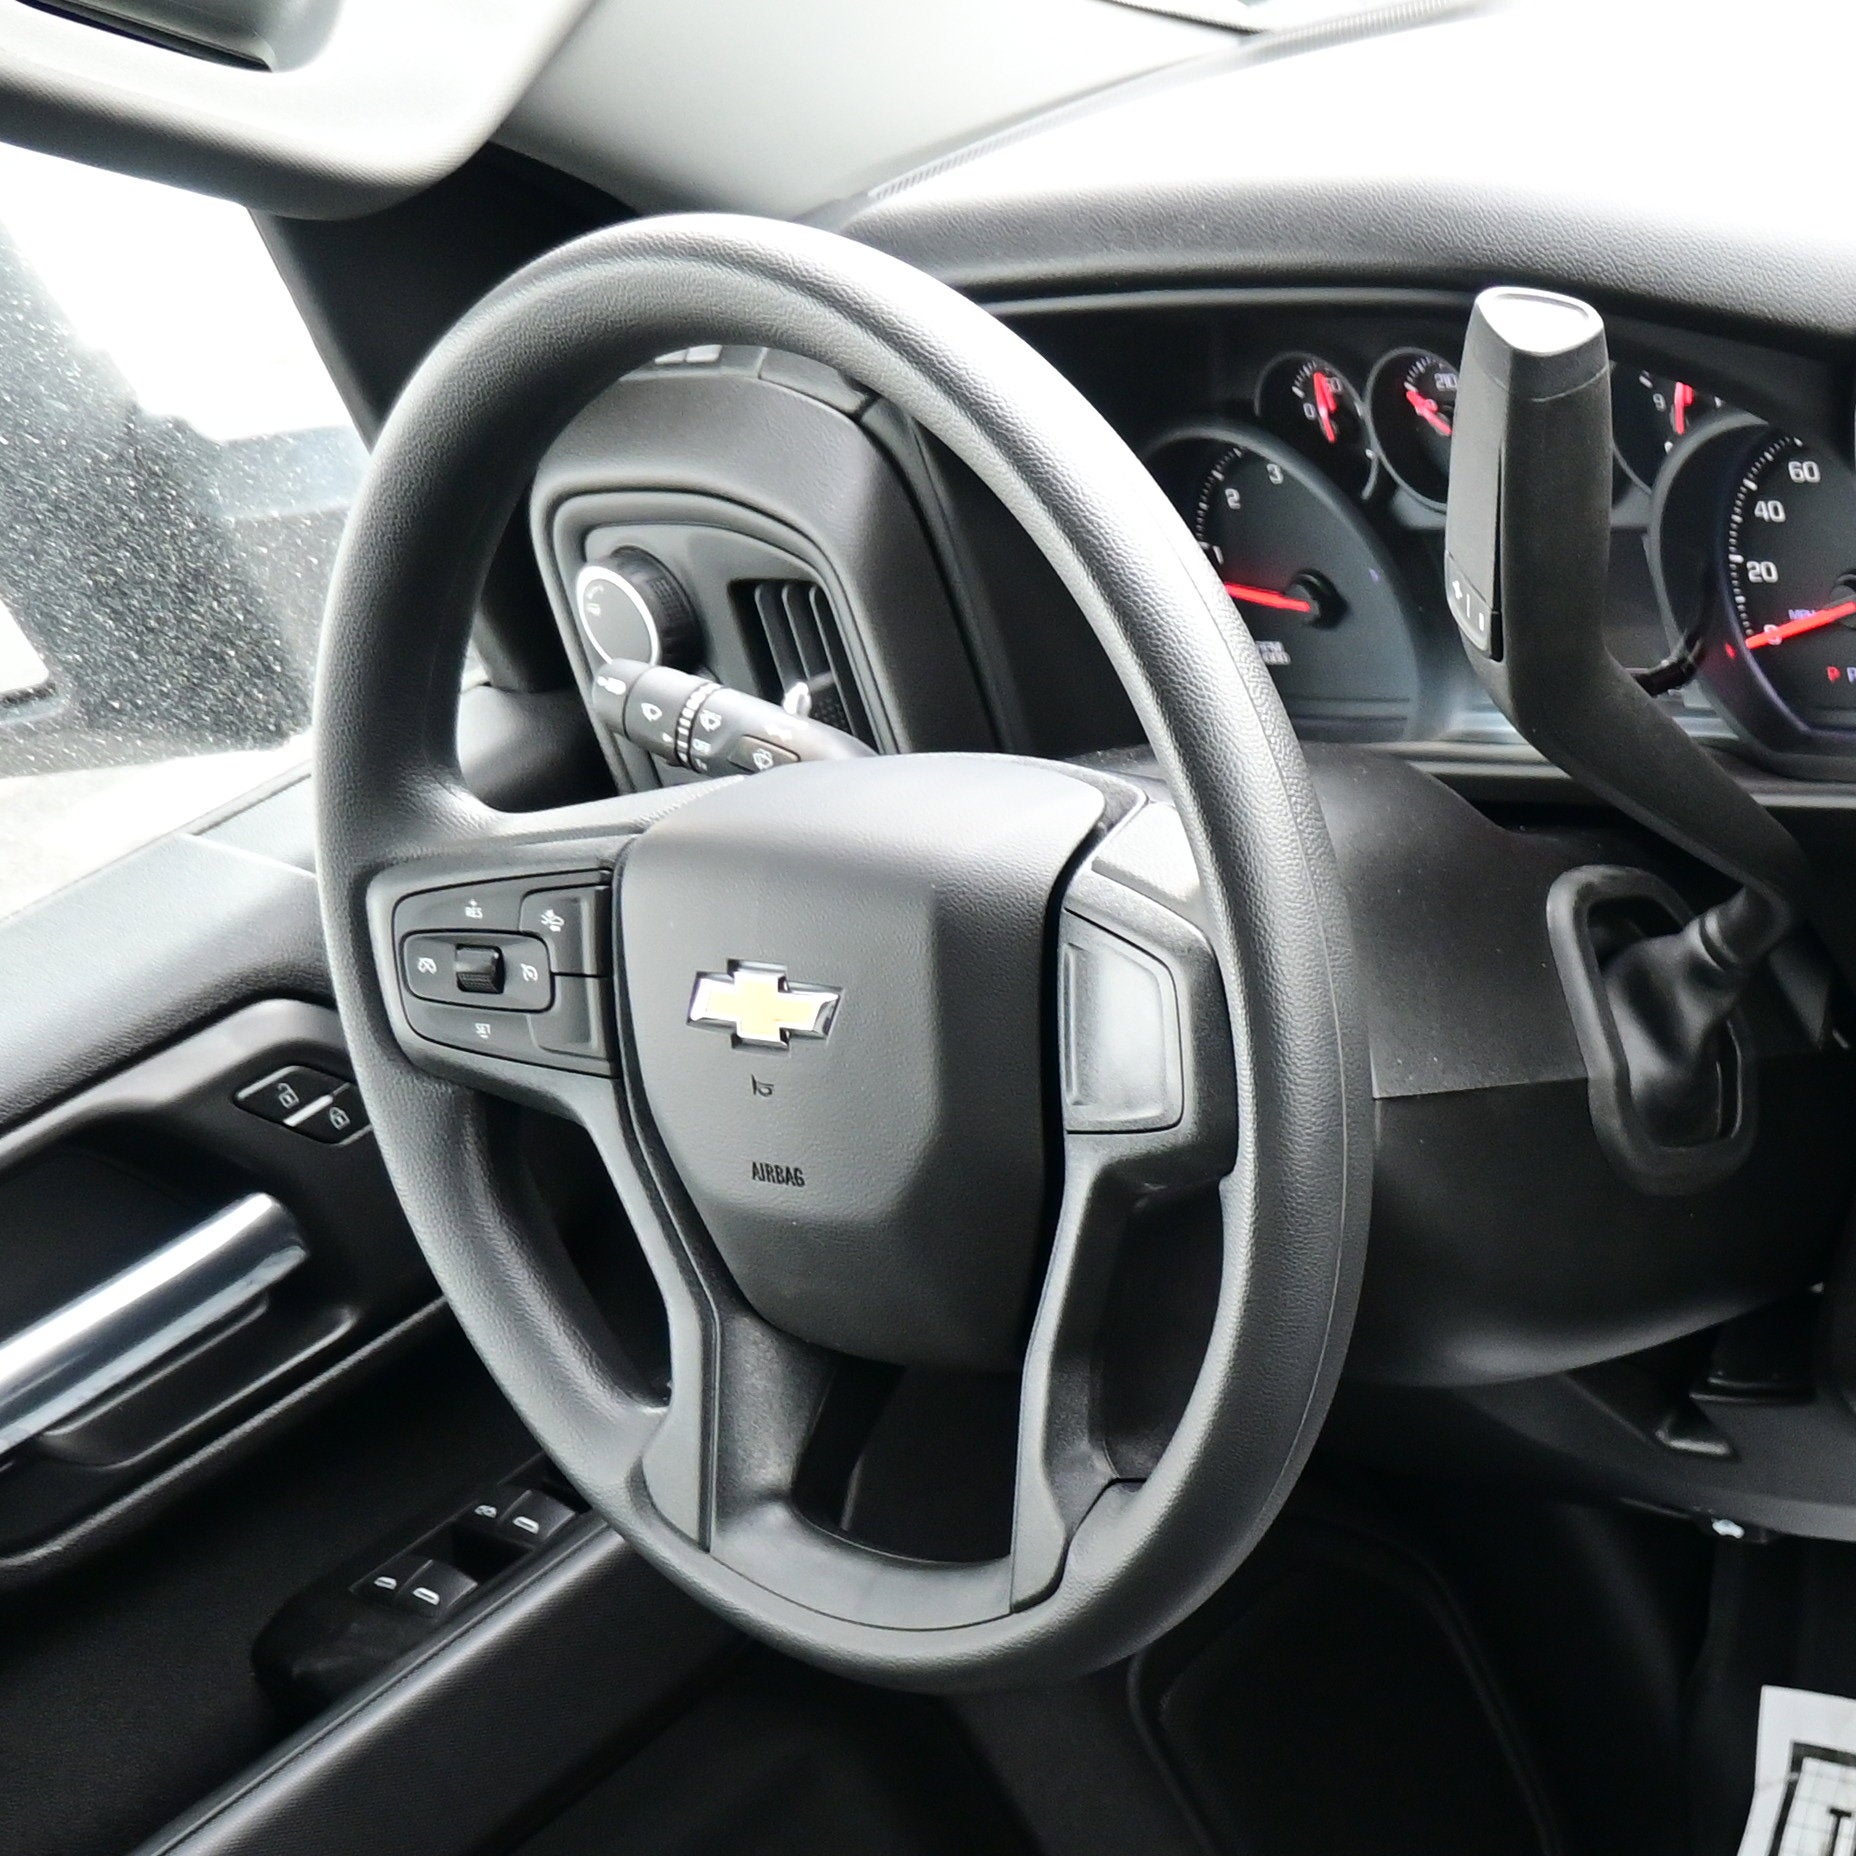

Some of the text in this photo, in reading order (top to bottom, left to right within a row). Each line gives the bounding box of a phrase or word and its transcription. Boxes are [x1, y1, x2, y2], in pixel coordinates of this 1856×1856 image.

[1303, 403, 1316, 420] 0
[1267, 464, 1283, 484] 3
[1788, 461, 1820, 483] 60
[1225, 488, 1241, 509] 2
[1754, 501, 1786, 522] 40
[1746, 561, 1778, 583] 20
[1827, 666, 1841, 682] P
[752, 1162, 805, 1187] AIRBAG
